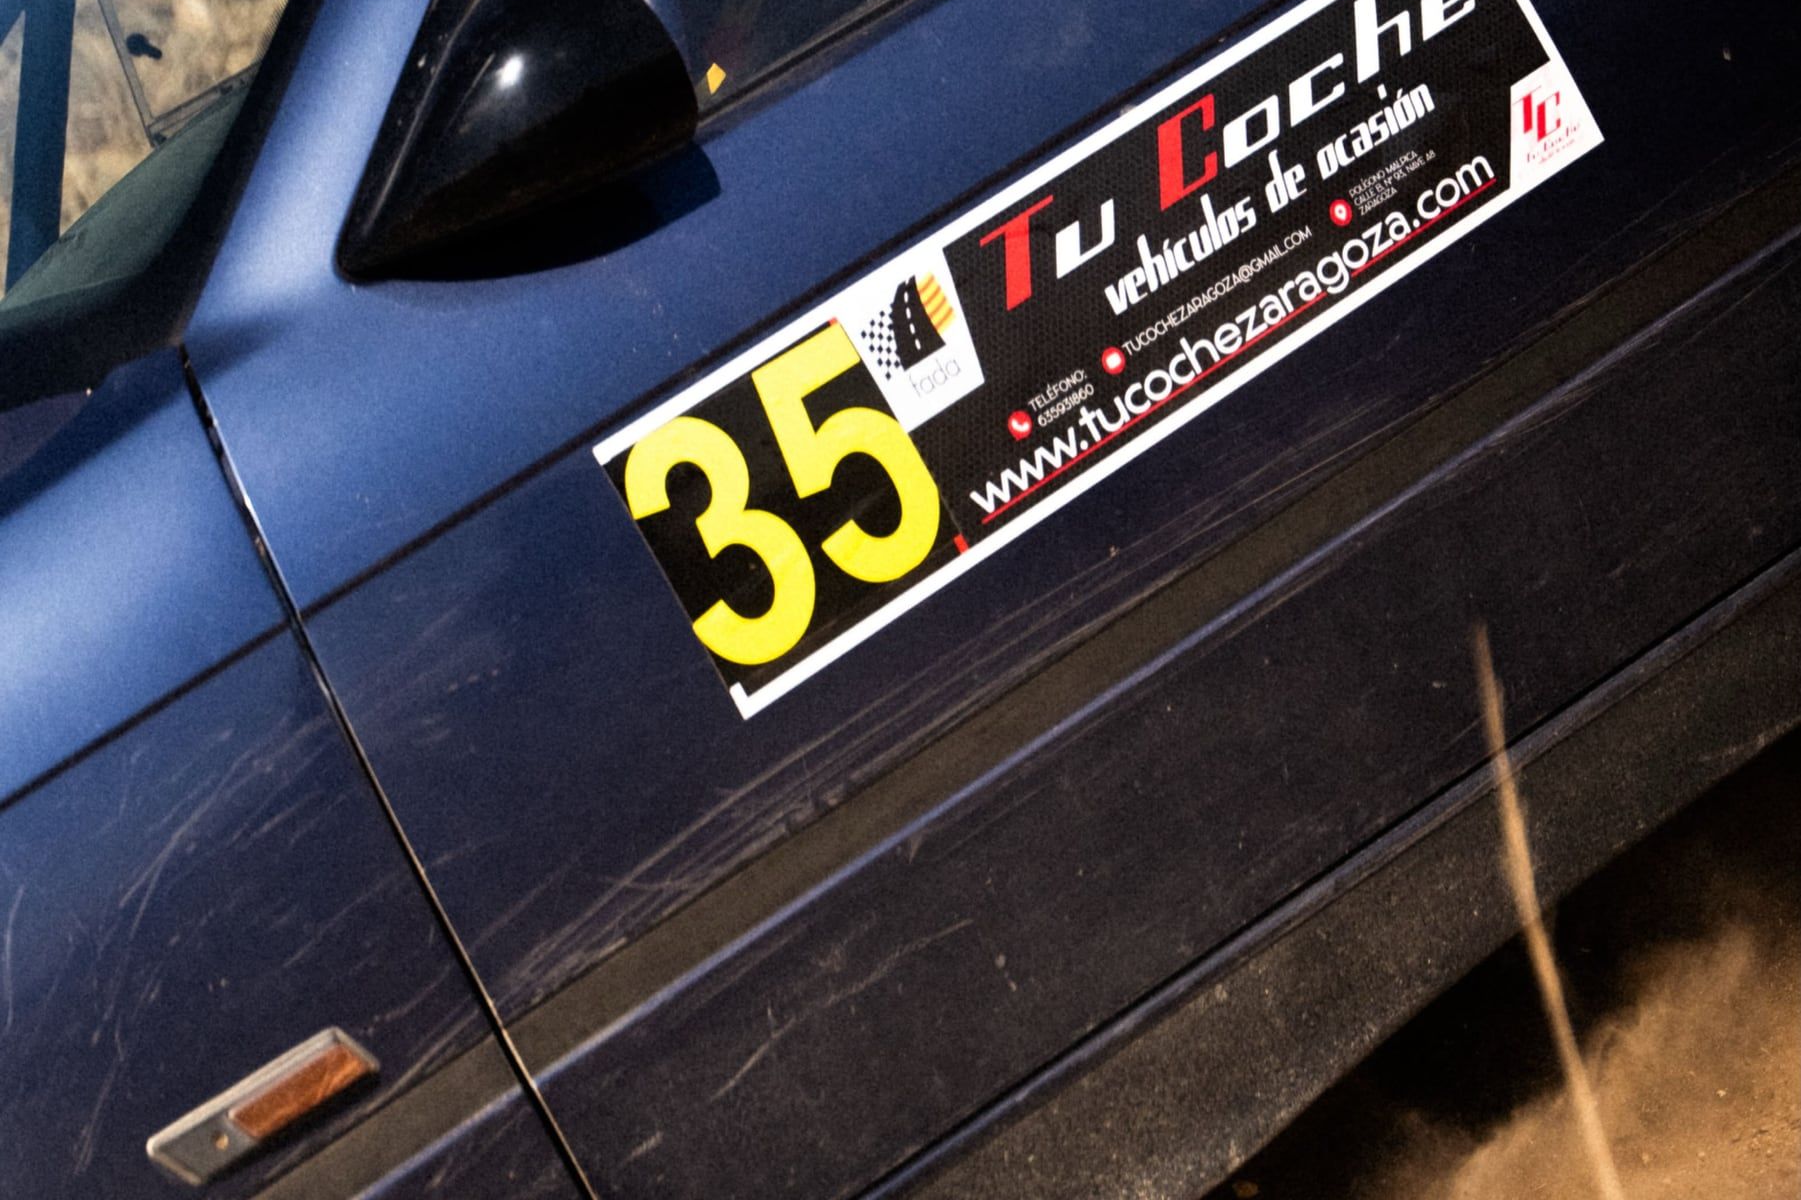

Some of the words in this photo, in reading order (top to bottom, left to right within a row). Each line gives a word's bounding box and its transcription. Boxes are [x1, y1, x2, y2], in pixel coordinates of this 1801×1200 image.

[1104, 193, 1257, 316] vehículos
[1265, 149, 1308, 214] de
[1316, 83, 1436, 181] ocasión
[1353, 186, 1377, 207] CALLE
[1405, 155, 1426, 173] NAVE
[1359, 186, 1399, 217] ZARAGOZA
[979, 194, 1116, 312] Tu
[1121, 225, 1313, 357] TUCOCHEZARAGOZA@GMAIL.COM
[969, 155, 1496, 515] www.tucochezaragoza.com
[1027, 368, 1089, 413] TELÉFONO:
[1037, 383, 1095, 428] 635931860
[624, 318, 941, 666] 35
